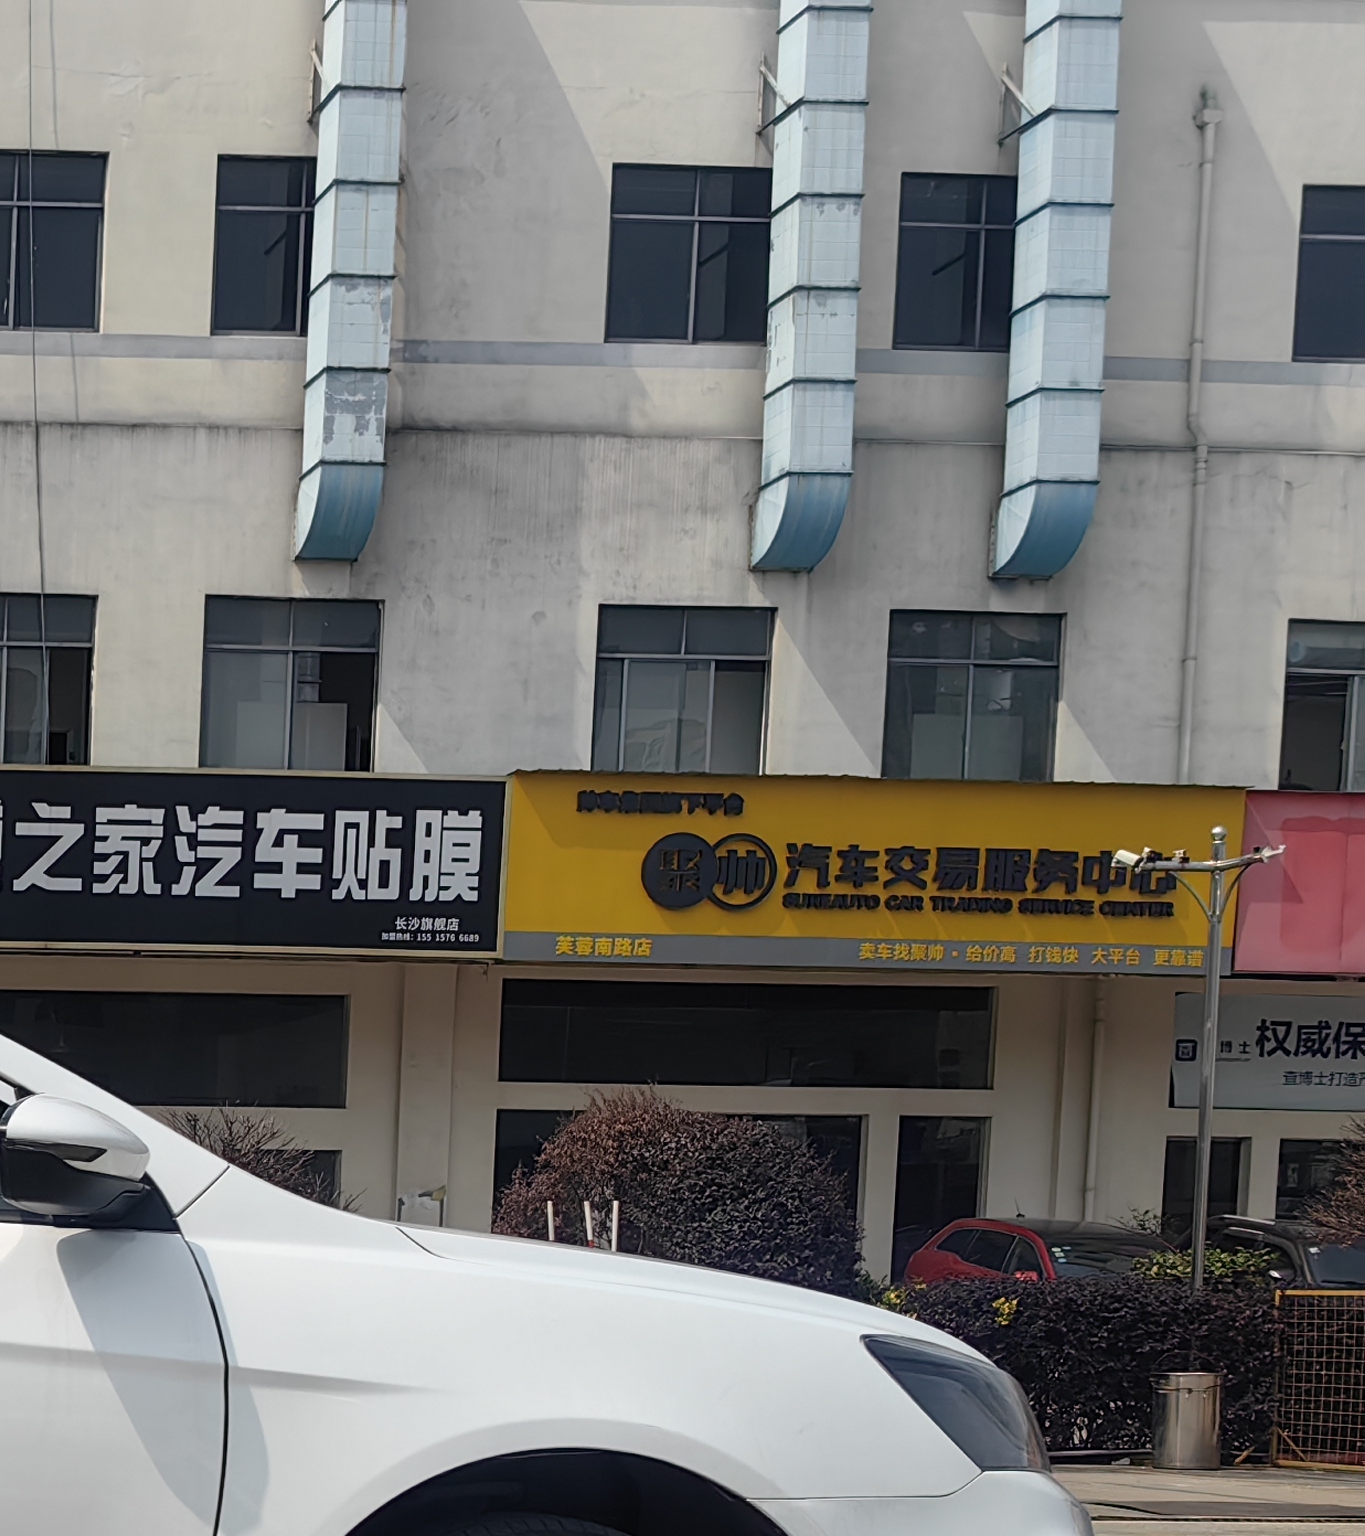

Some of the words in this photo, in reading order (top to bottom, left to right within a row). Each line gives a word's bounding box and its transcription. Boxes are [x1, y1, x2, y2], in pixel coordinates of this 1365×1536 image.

[784, 843, 1177, 894] 汽车交易服务中心
[884, 894, 925, 911] CAR
[394, 916, 460, 931] 长沙旗舰店
[555, 935, 653, 957] 芙蓉南路店
[966, 945, 1017, 963] 给价高
[1091, 947, 1141, 965] 大平台
[1255, 1018, 1365, 1060] 权威保
